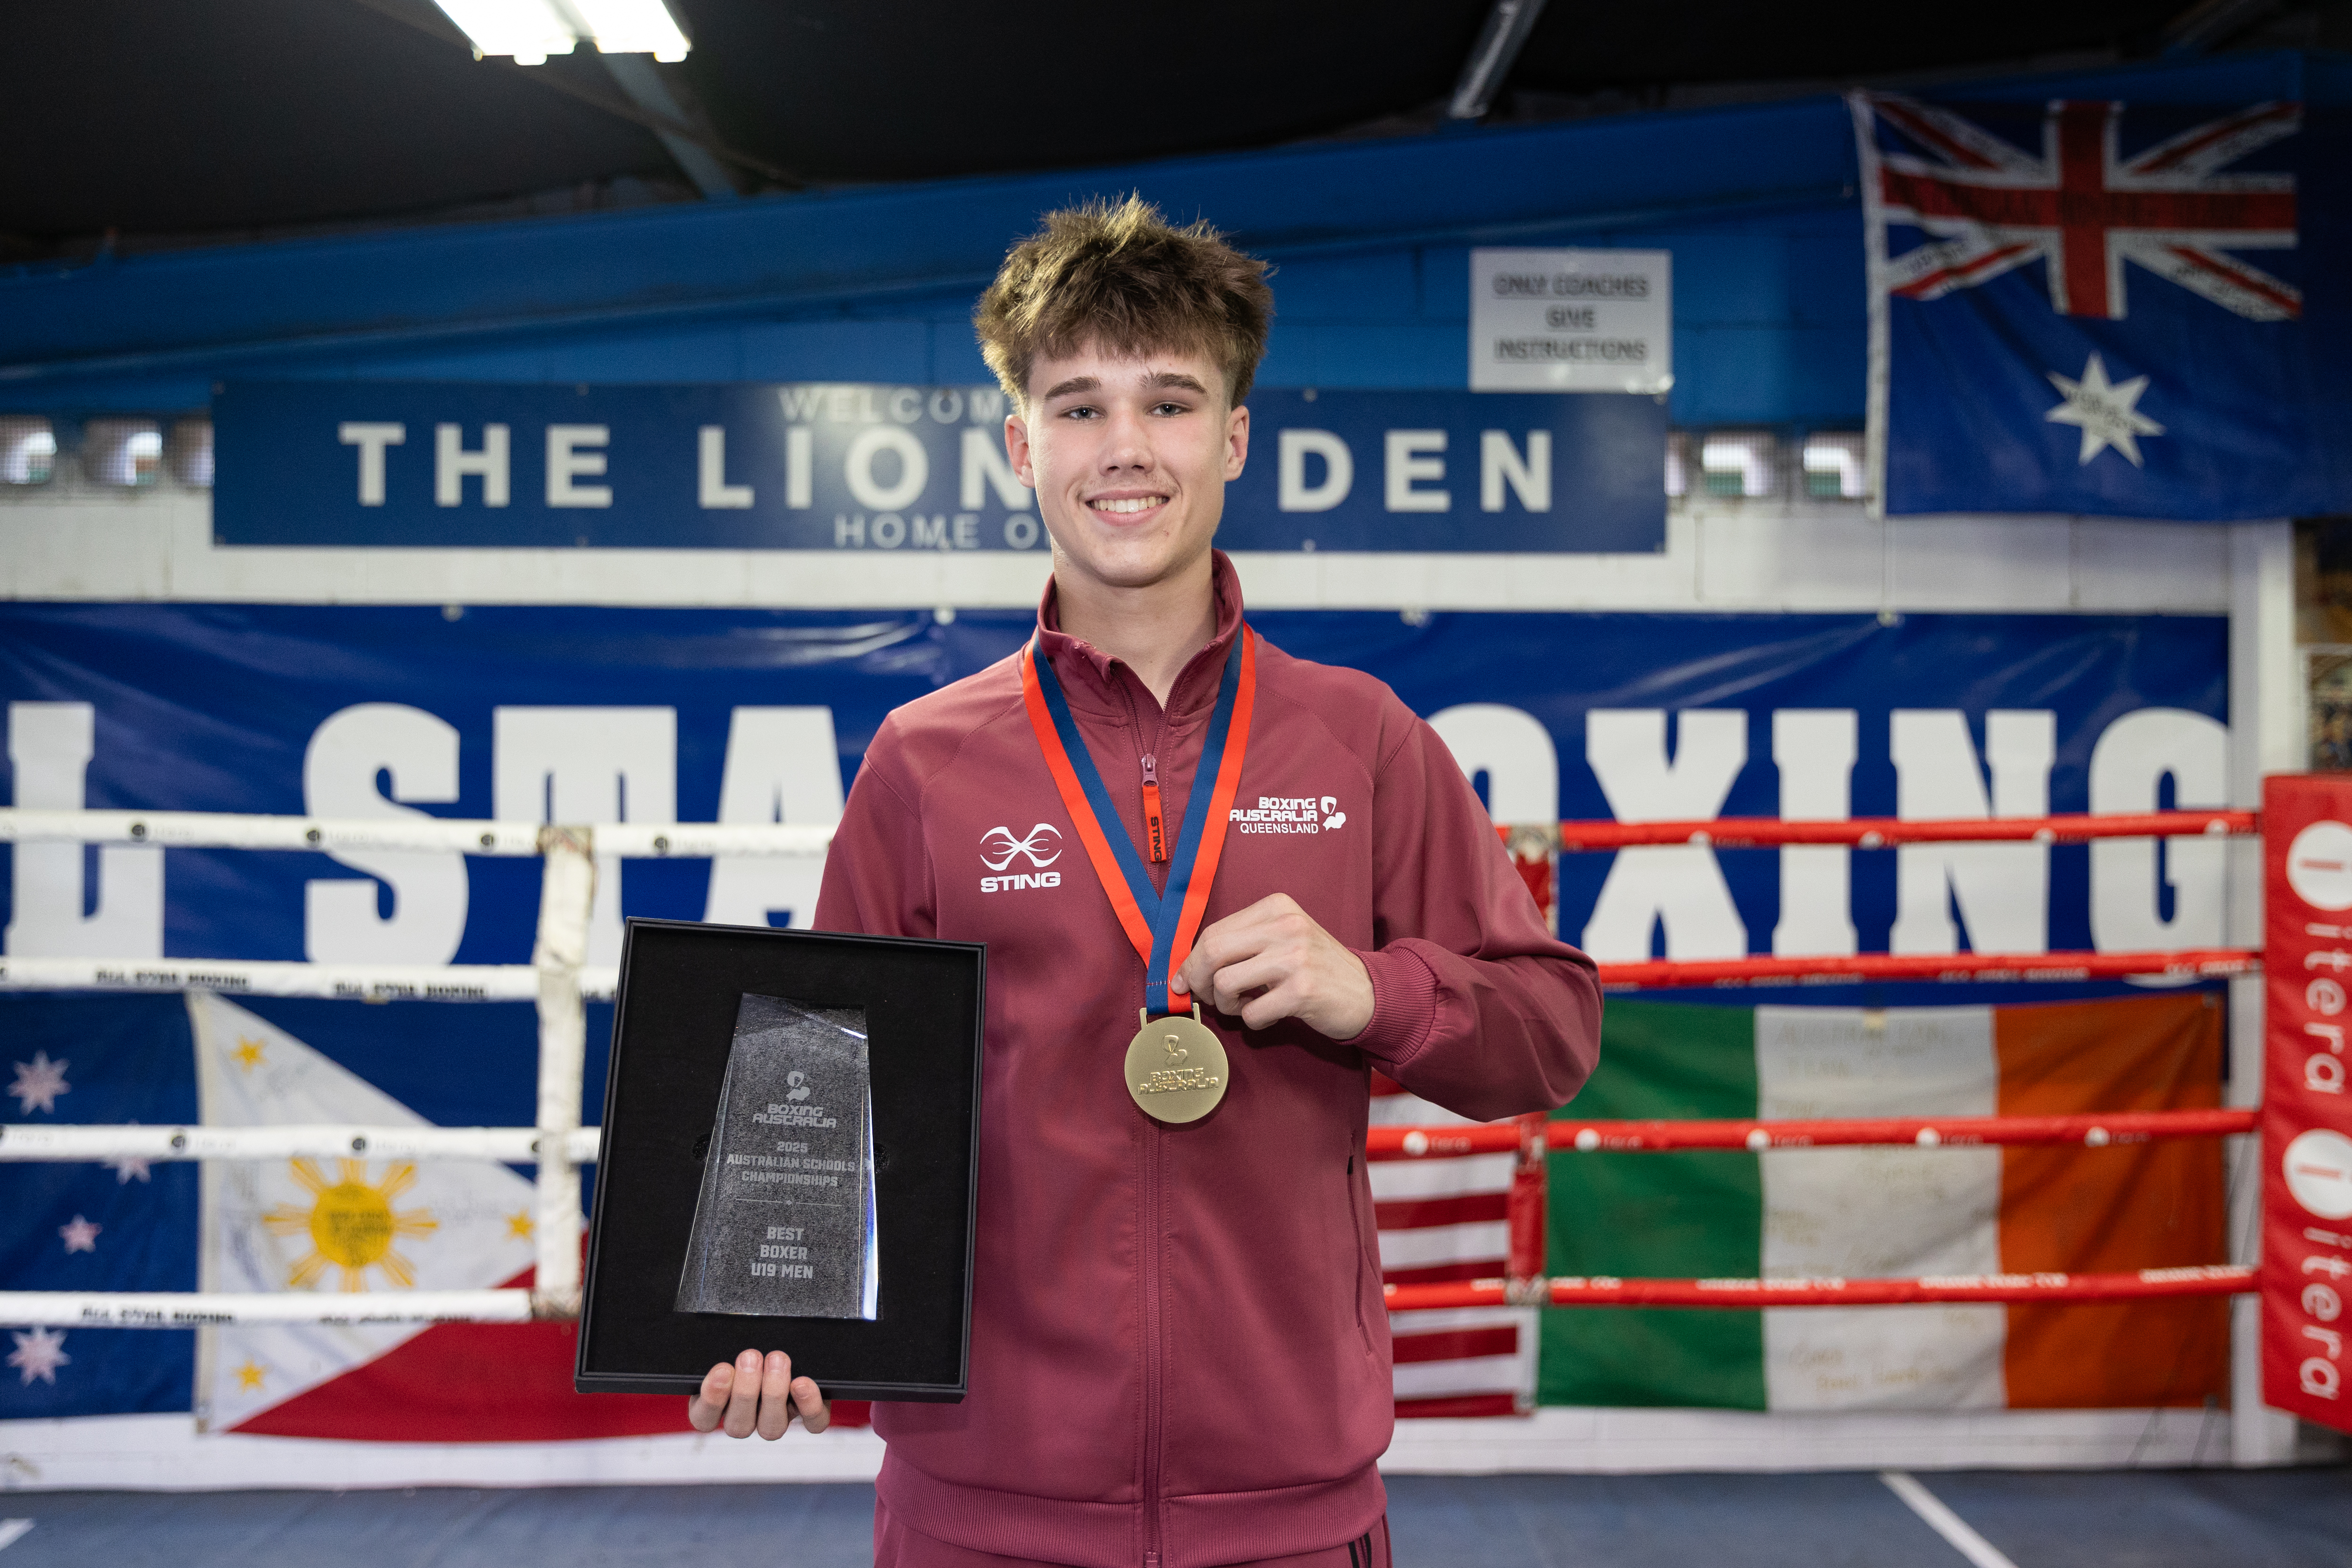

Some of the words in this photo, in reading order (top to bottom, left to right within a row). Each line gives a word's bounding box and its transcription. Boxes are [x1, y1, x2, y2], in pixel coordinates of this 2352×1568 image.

[1493, 272, 1548, 296] ONLY
[1552, 273, 1650, 298] COACHES
[1492, 336, 1649, 361] INSTRUCTIONS
[777, 386, 1015, 424] WELCOM
[338, 422, 614, 508] THE
[1278, 428, 1552, 513] DEN
[834, 513, 981, 549] HOME
[1004, 513, 1051, 549] O
[1258, 796, 1316, 810] BOXING
[1229, 809, 1318, 822] AUSTRALIA
[1239, 822, 1319, 834] QUEENSLAND
[1150, 816, 1162, 861] STING
[980, 871, 1061, 893] STING
[767, 1103, 824, 1117] BOXING
[752, 1113, 837, 1129] AUSTRALIA
[777, 1141, 808, 1153] 2025
[726, 1154, 800, 1168] AUSTRALIAN
[802, 1158, 855, 1172] SCHOOLS
[742, 1170, 838, 1187] CHAMPIONSHIPS
[767, 1226, 804, 1241] BEST
[759, 1244, 808, 1260] BOXER
[751, 1262, 776, 1277] U19
[781, 1264, 813, 1279] MEN
